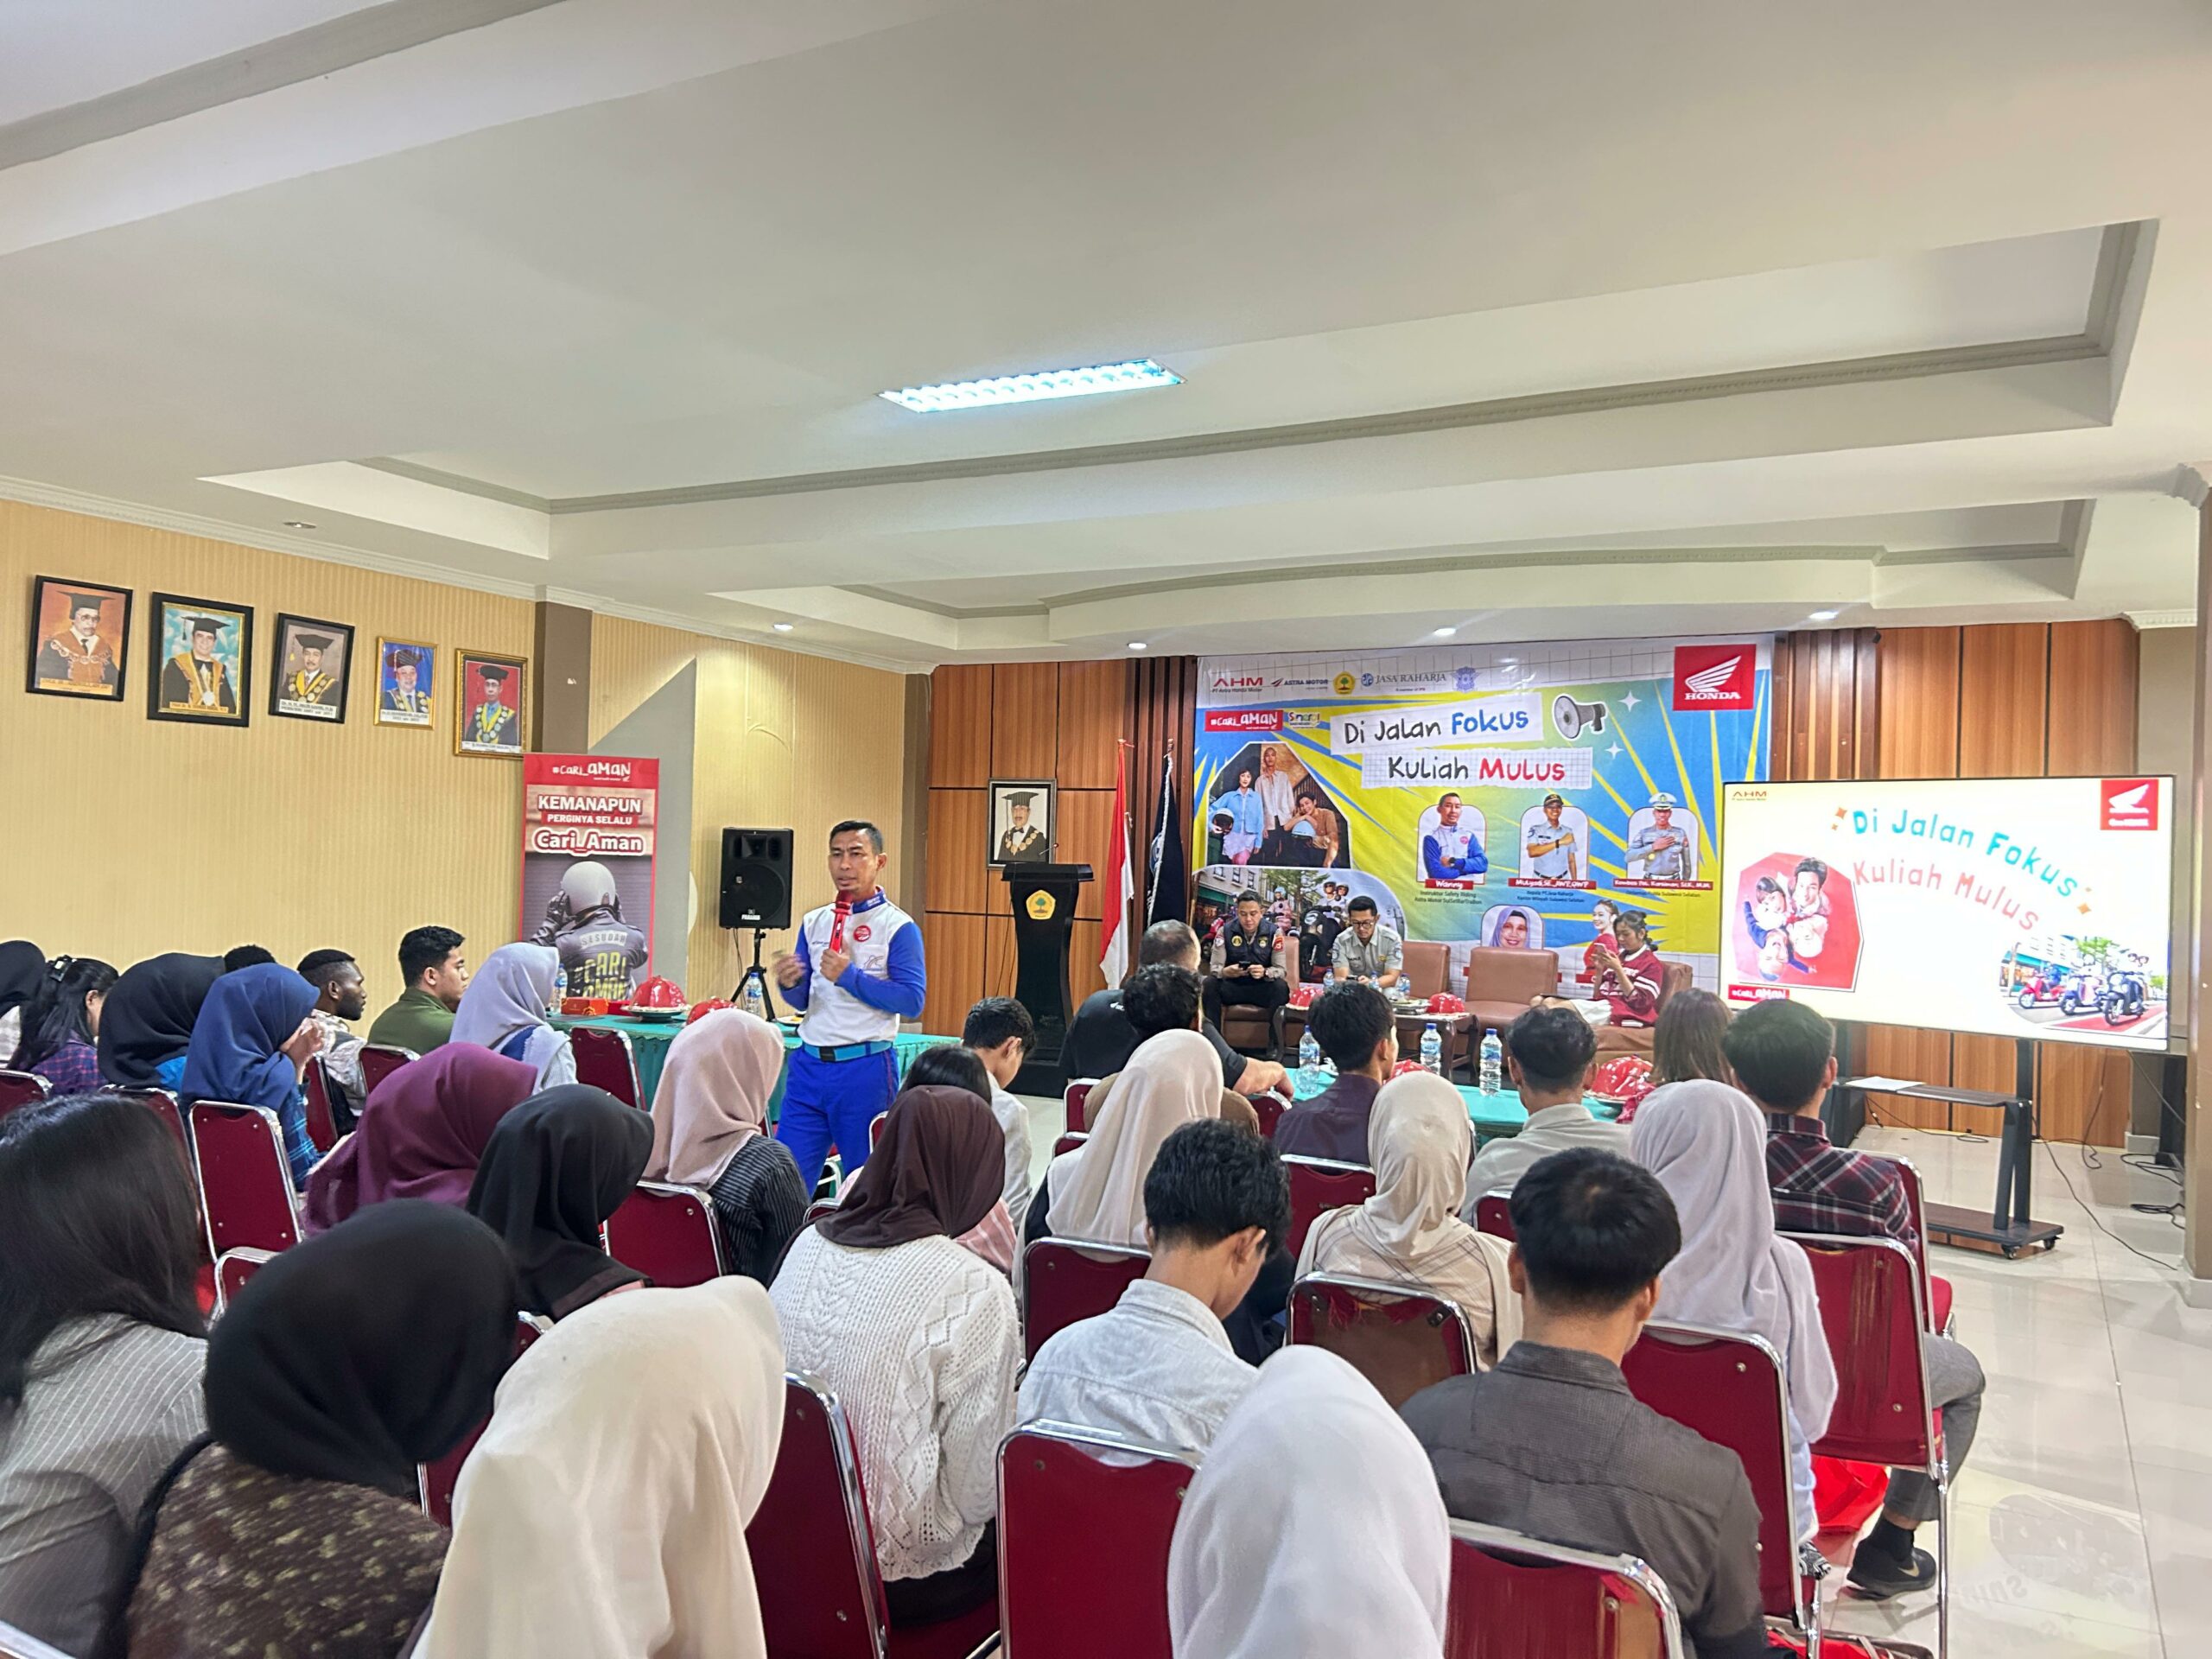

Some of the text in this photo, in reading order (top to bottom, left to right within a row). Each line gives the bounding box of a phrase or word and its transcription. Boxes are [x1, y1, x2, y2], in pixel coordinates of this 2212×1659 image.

[1213, 677, 1262, 687] AHM
[1401, 673, 1446, 683] RAHARJA
[1344, 721, 1364, 744] Di
[1374, 718, 1441, 741] Jalan
[537, 795, 641, 812] KEMANAPUN
[547, 814, 632, 824] PERGINYA SELALU
[537, 830, 642, 851] Cari_Aman
[1853, 808, 2077, 897] Di Jalan Fokus
[1853, 858, 2039, 930] Kuliah Mulus
[581, 933, 626, 946] SESUDAH
